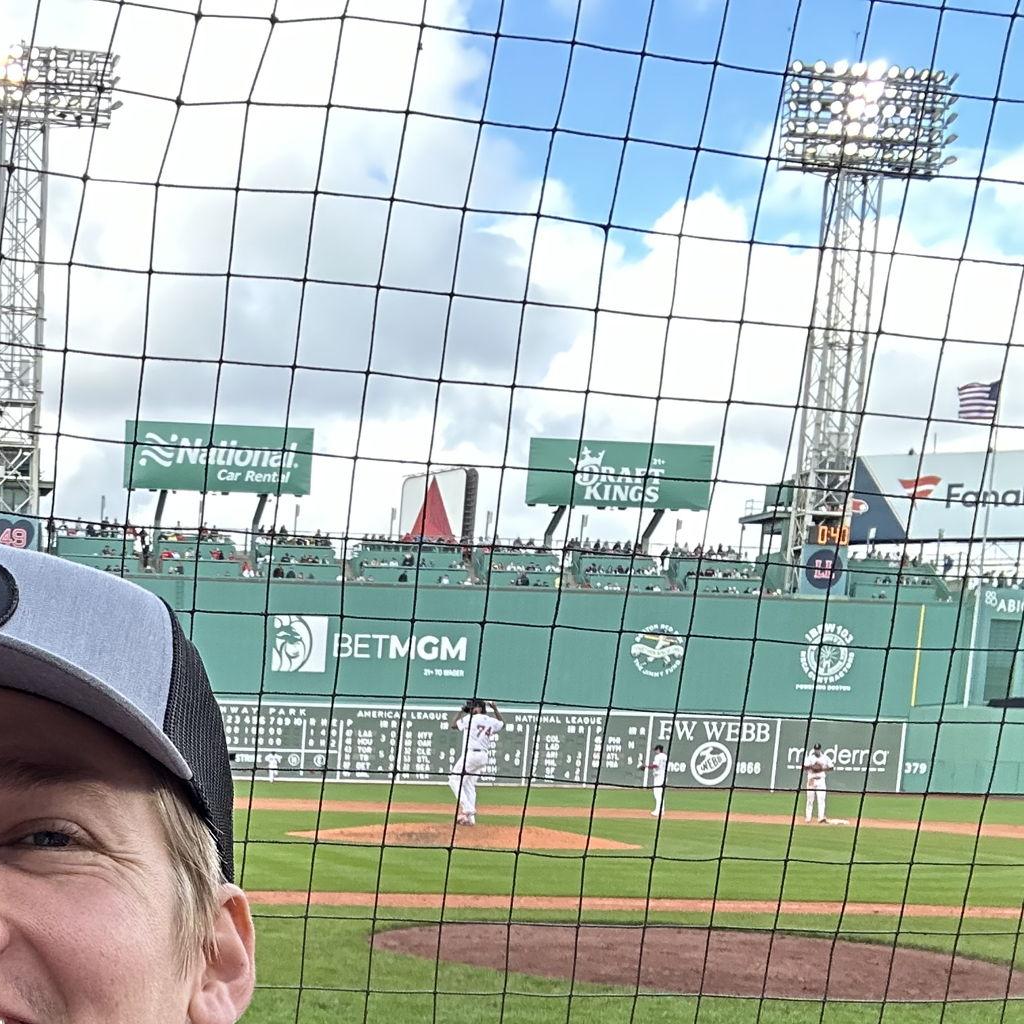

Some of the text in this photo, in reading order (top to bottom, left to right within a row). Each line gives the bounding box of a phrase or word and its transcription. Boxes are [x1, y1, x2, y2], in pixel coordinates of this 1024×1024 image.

[216, 468, 291, 484] Car Rental
[574, 463, 665, 487] DRAFT
[584, 481, 660, 503] KINGS
[945, 483, 1024, 509] Fana
[817, 525, 850, 547] 0:40
[996, 598, 1024, 613] ABI
[332, 632, 468, 662] BETMGM
[435, 668, 443, 677] TO
[269, 707, 307, 717] PARK
[357, 710, 449, 721] AMERICAN LEAGUE
[347, 718, 354, 728] P
[406, 720, 413, 729] P
[515, 714, 603, 726] NATIONAL LEAGUE
[477, 725, 493, 738] 74
[578, 725, 585, 735] R
[596, 726, 603, 735] P
[658, 719, 771, 743] F.W. WEBB
[357, 738, 373, 747] HOU
[545, 734, 560, 744] COL
[356, 746, 373, 755] TOR
[416, 747, 431, 756] CLE
[545, 742, 560, 751] LAD
[606, 752, 620, 761] ATL
[904, 762, 928, 774] 379
